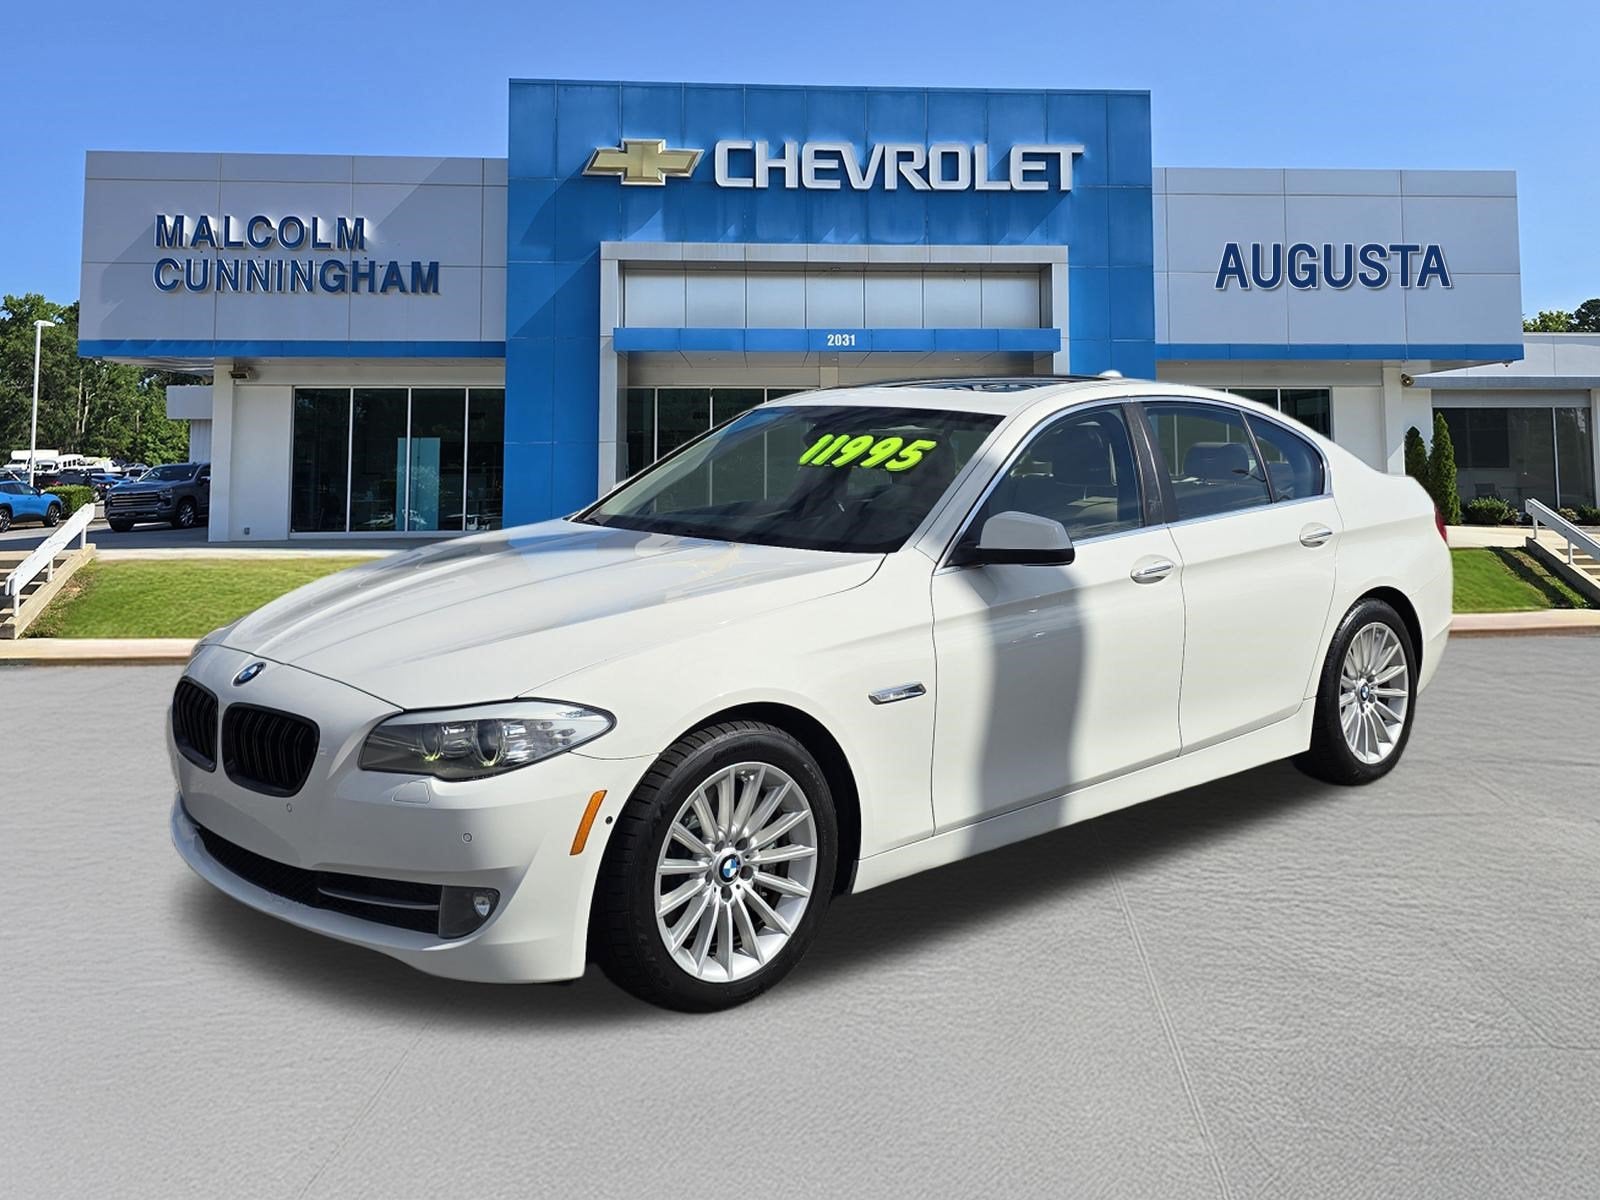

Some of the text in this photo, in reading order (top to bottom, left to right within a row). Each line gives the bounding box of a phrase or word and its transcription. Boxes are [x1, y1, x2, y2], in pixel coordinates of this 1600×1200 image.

[714, 140, 1084, 191] CHEVROLET
[155, 214, 366, 250] MALCOLM
[154, 257, 440, 293] CUNNINGHAM
[1215, 242, 1452, 289] AUGUSTA
[827, 334, 856, 346] 2031
[799, 434, 937, 471] 11995
